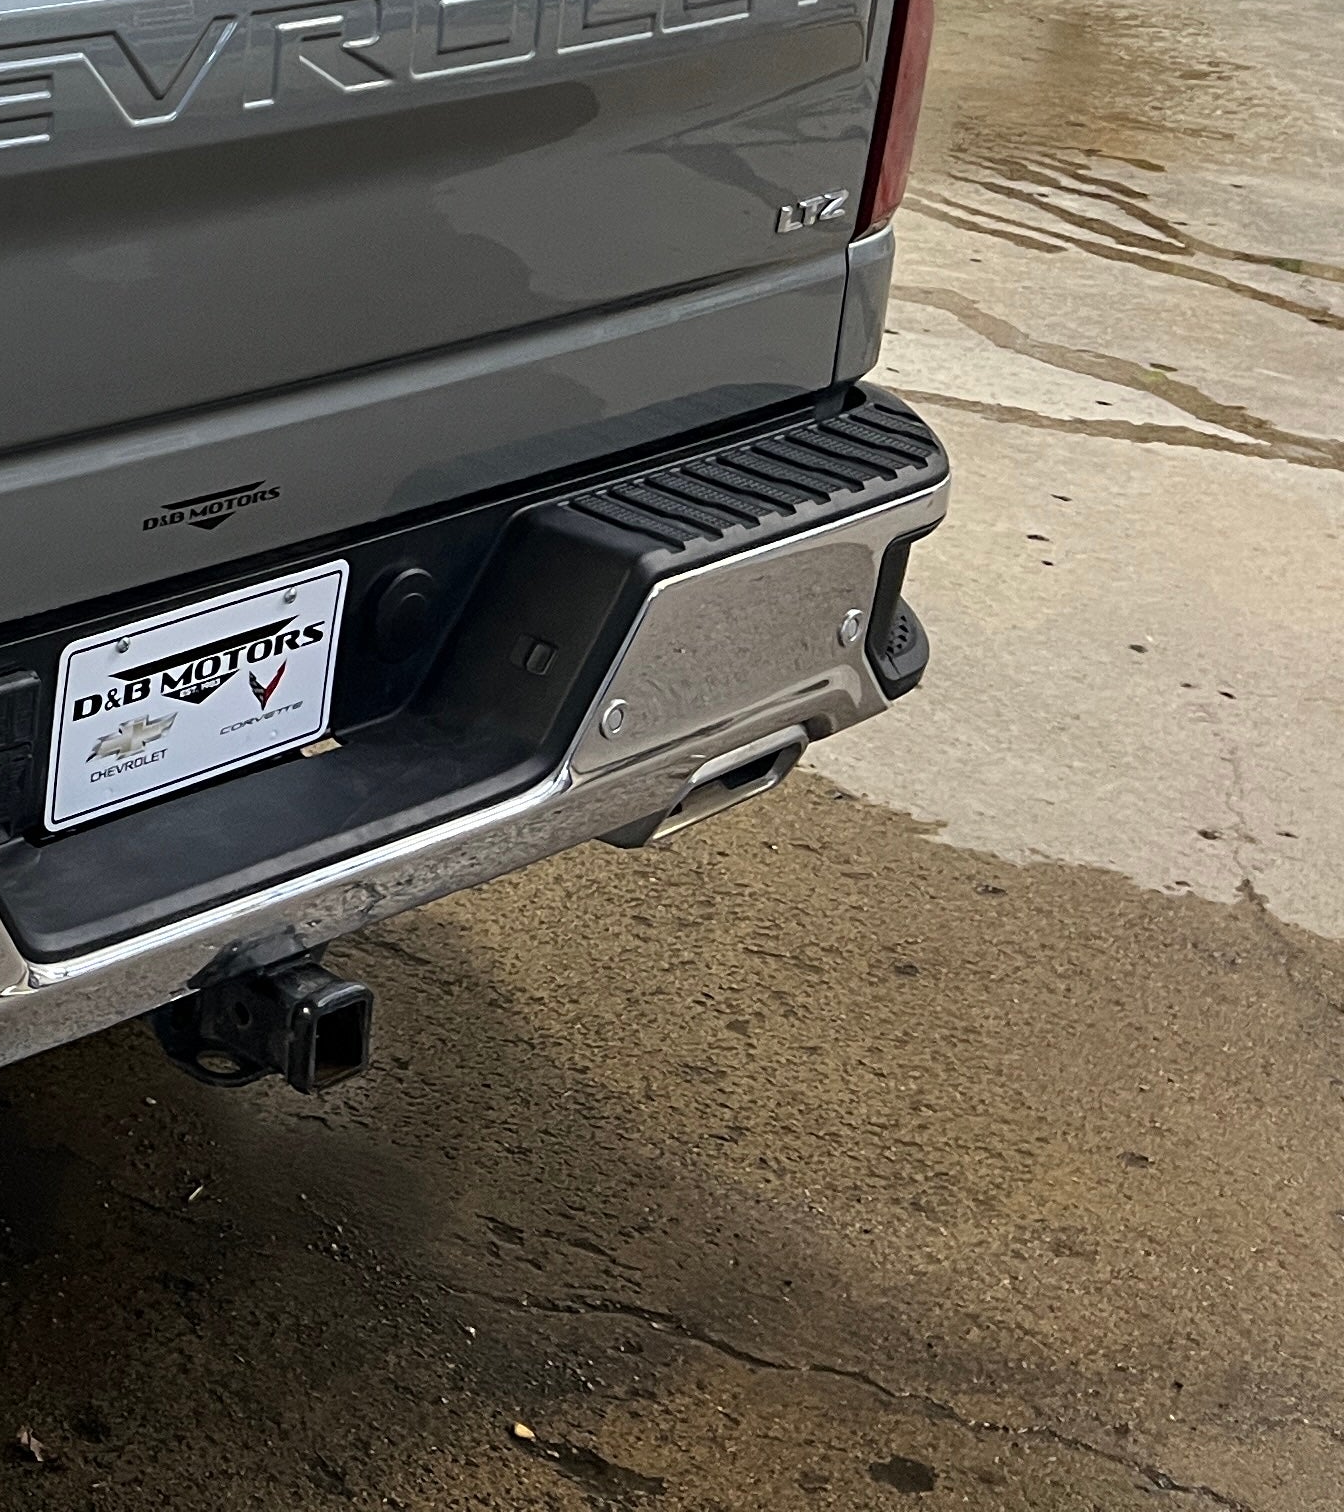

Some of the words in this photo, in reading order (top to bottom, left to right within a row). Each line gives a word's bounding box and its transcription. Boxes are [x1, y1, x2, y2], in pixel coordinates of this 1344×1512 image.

[776, 188, 850, 234] LTZ
[141, 510, 186, 532] D&B
[188, 485, 281, 520] MOTORS
[72, 677, 152, 723] D&B
[160, 620, 326, 695] MOTORS
[219, 700, 304, 736] CORVETTE
[89, 747, 169, 784] CHEVROLET
